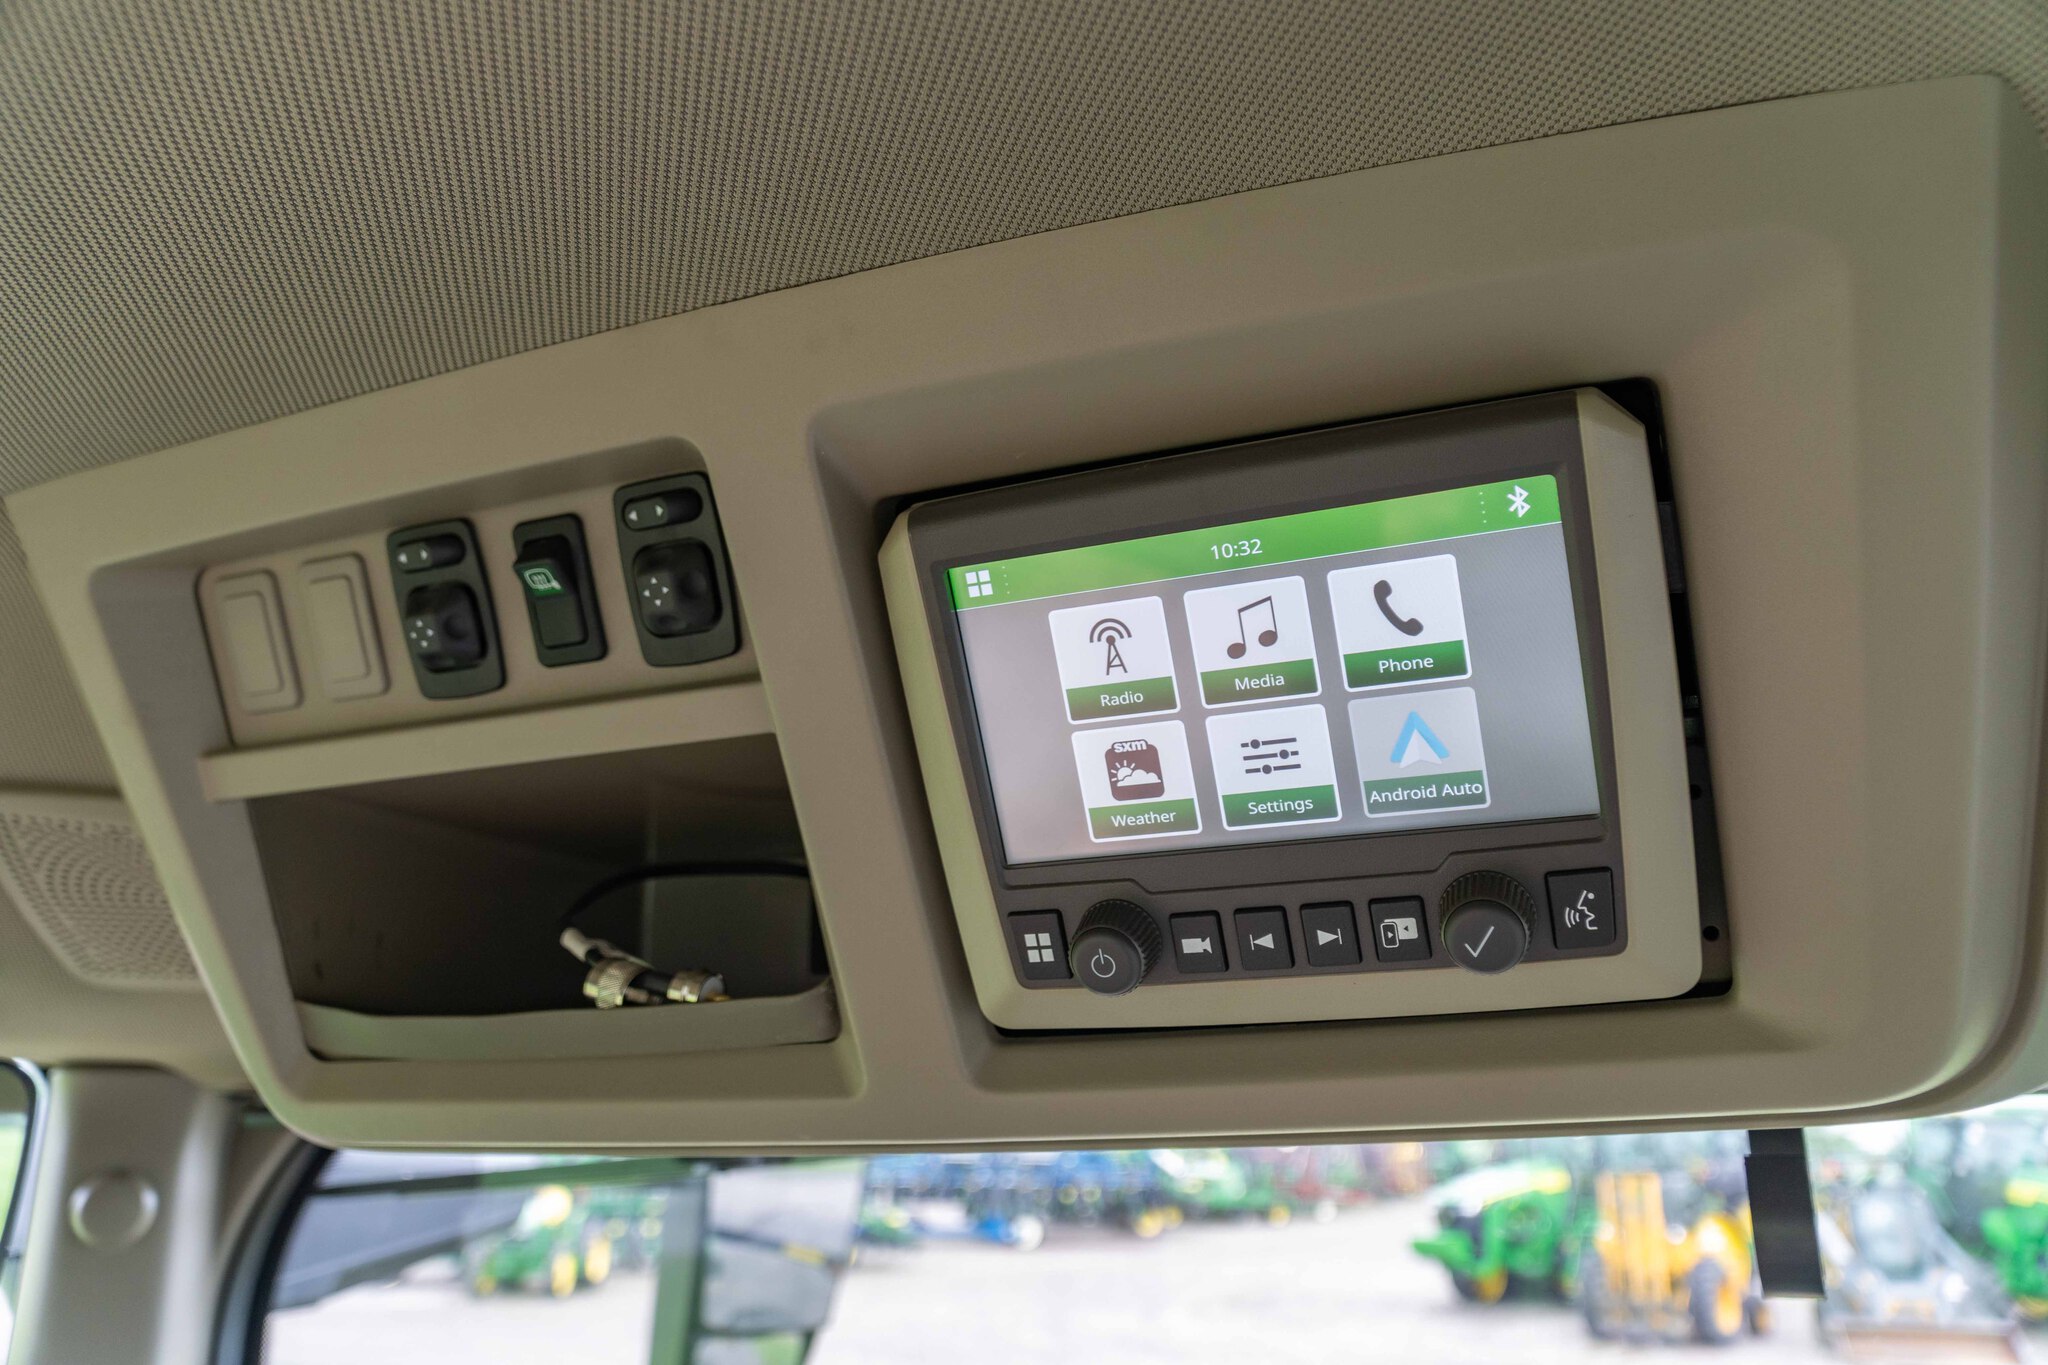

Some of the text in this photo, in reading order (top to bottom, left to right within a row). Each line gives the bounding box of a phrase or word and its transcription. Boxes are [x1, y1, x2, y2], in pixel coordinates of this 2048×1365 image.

[1210, 538, 1263, 560] 10:32
[1378, 656, 1434, 673] Phone
[1235, 673, 1285, 690] Media
[1100, 689, 1144, 707] Radio
[1114, 739, 1147, 753] sxm
[1369, 780, 1482, 803] Android Auto
[1248, 797, 1314, 816] Settings
[1111, 809, 1176, 827] Weather
